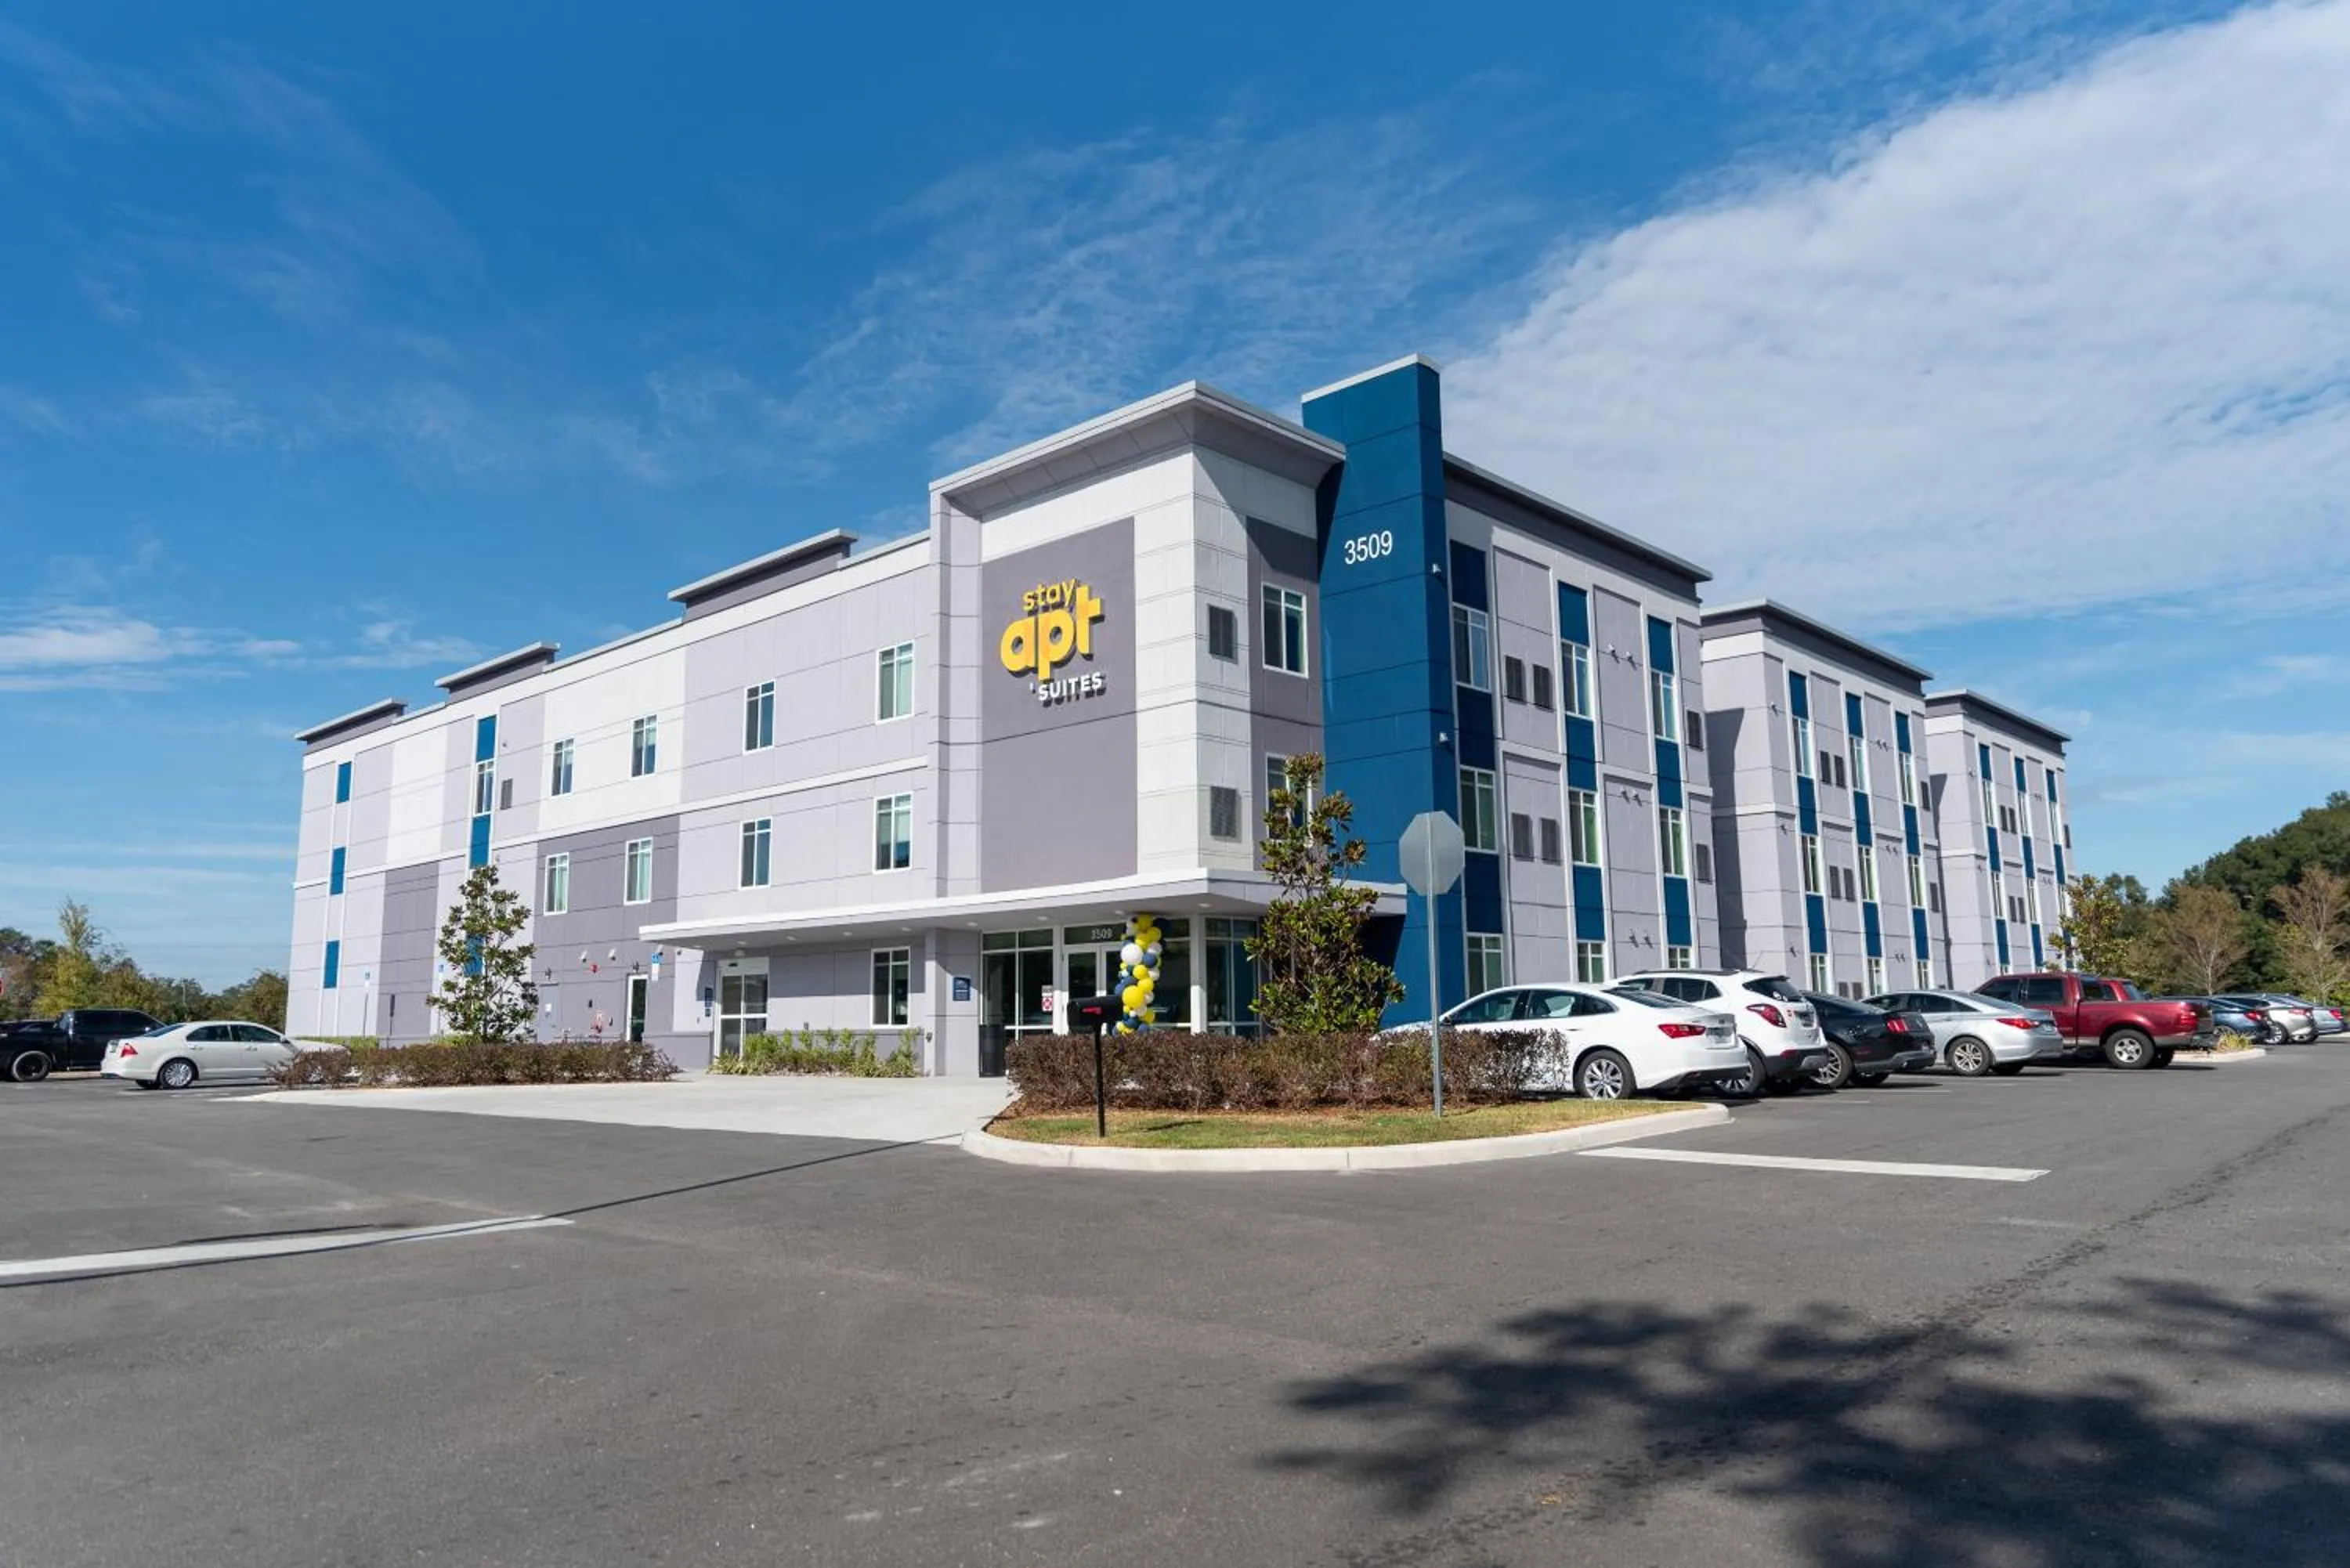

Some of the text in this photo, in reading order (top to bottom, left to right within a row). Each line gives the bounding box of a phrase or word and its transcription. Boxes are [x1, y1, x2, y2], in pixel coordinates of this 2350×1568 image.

[1344, 530, 1393, 565] 3509
[1022, 578, 1077, 612] stay
[1000, 584, 1101, 681] apt
[1038, 671, 1103, 701] SUITES
[1090, 927, 1113, 940] 3509
